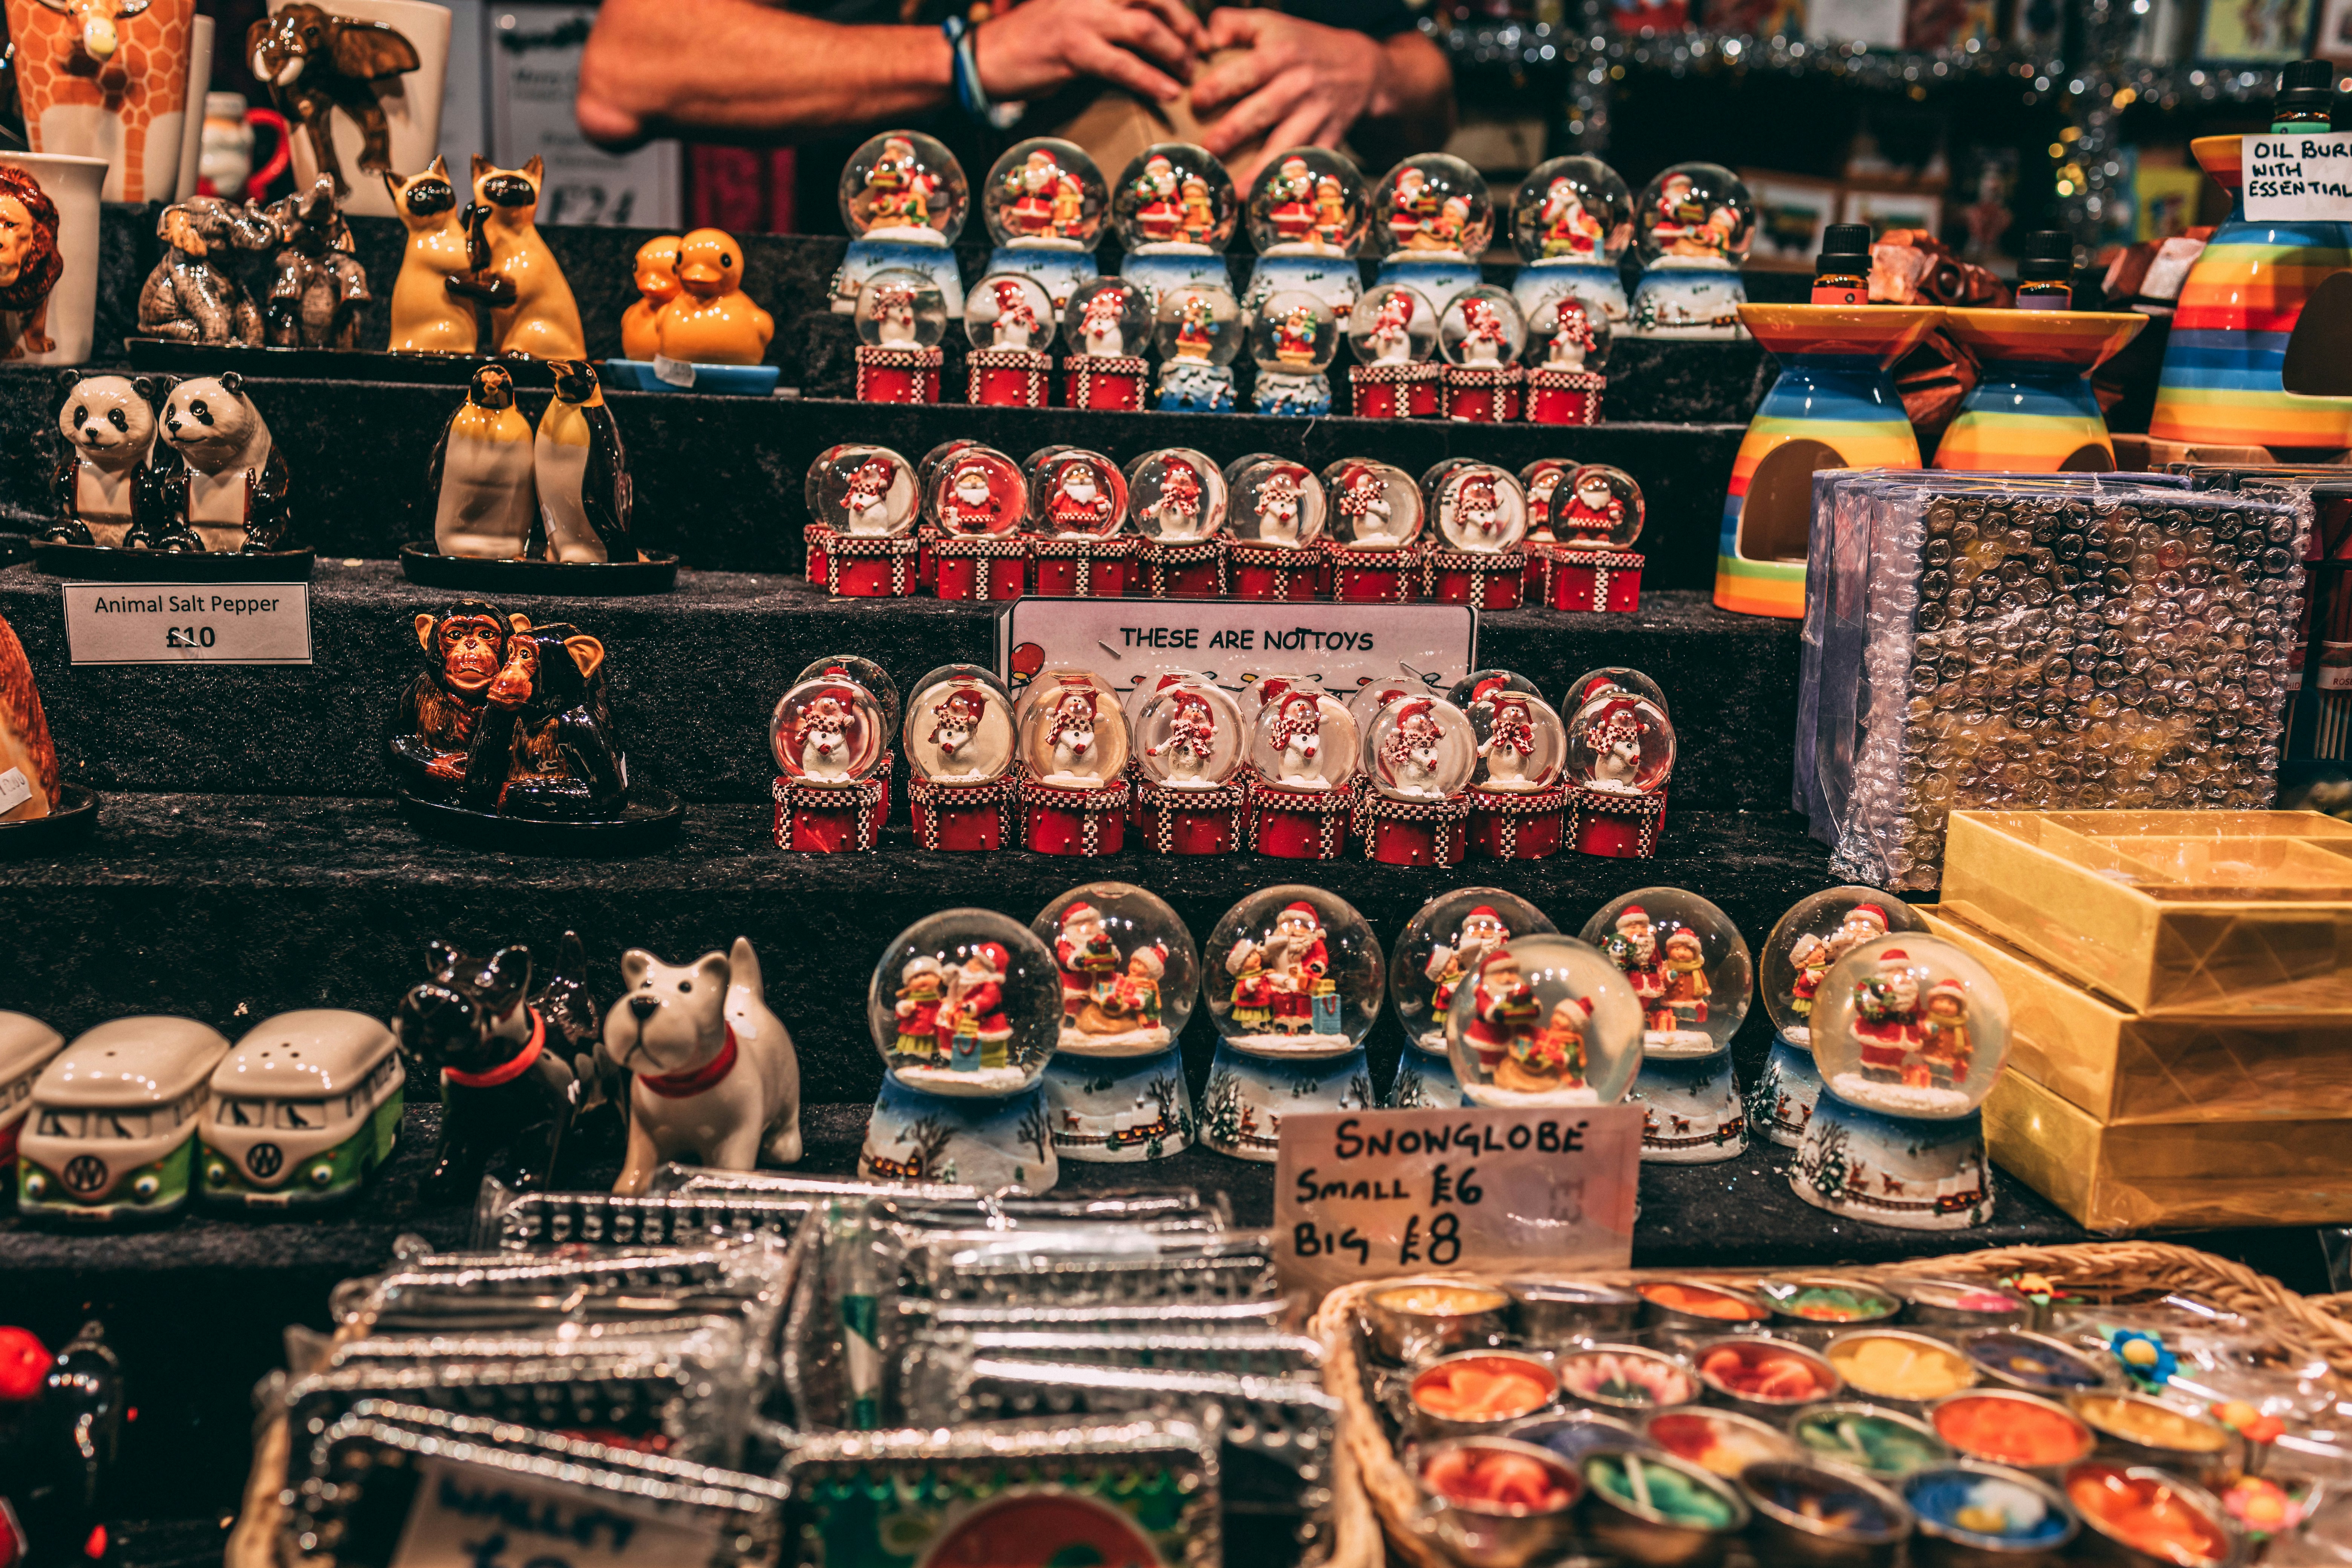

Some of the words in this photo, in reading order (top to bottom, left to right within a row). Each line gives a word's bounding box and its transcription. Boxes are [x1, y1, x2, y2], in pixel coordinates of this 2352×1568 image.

[2254, 142, 2294, 159] OIL
[2252, 161, 2302, 178] WITH
[95, 595, 162, 613] Animal
[169, 595, 205, 612] Salt
[211, 596, 280, 616] Pepper
[166, 626, 216, 648] £10
[1120, 627, 1199, 649] THESE
[1209, 630, 1254, 650] ARE
[1334, 1119, 1589, 1159] SNOWGLOBE
[1295, 1168, 1410, 1203] SMALL
[1430, 1164, 1482, 1207] £6
[1294, 1222, 1369, 1266] BIG
[1400, 1212, 1461, 1266] £8
